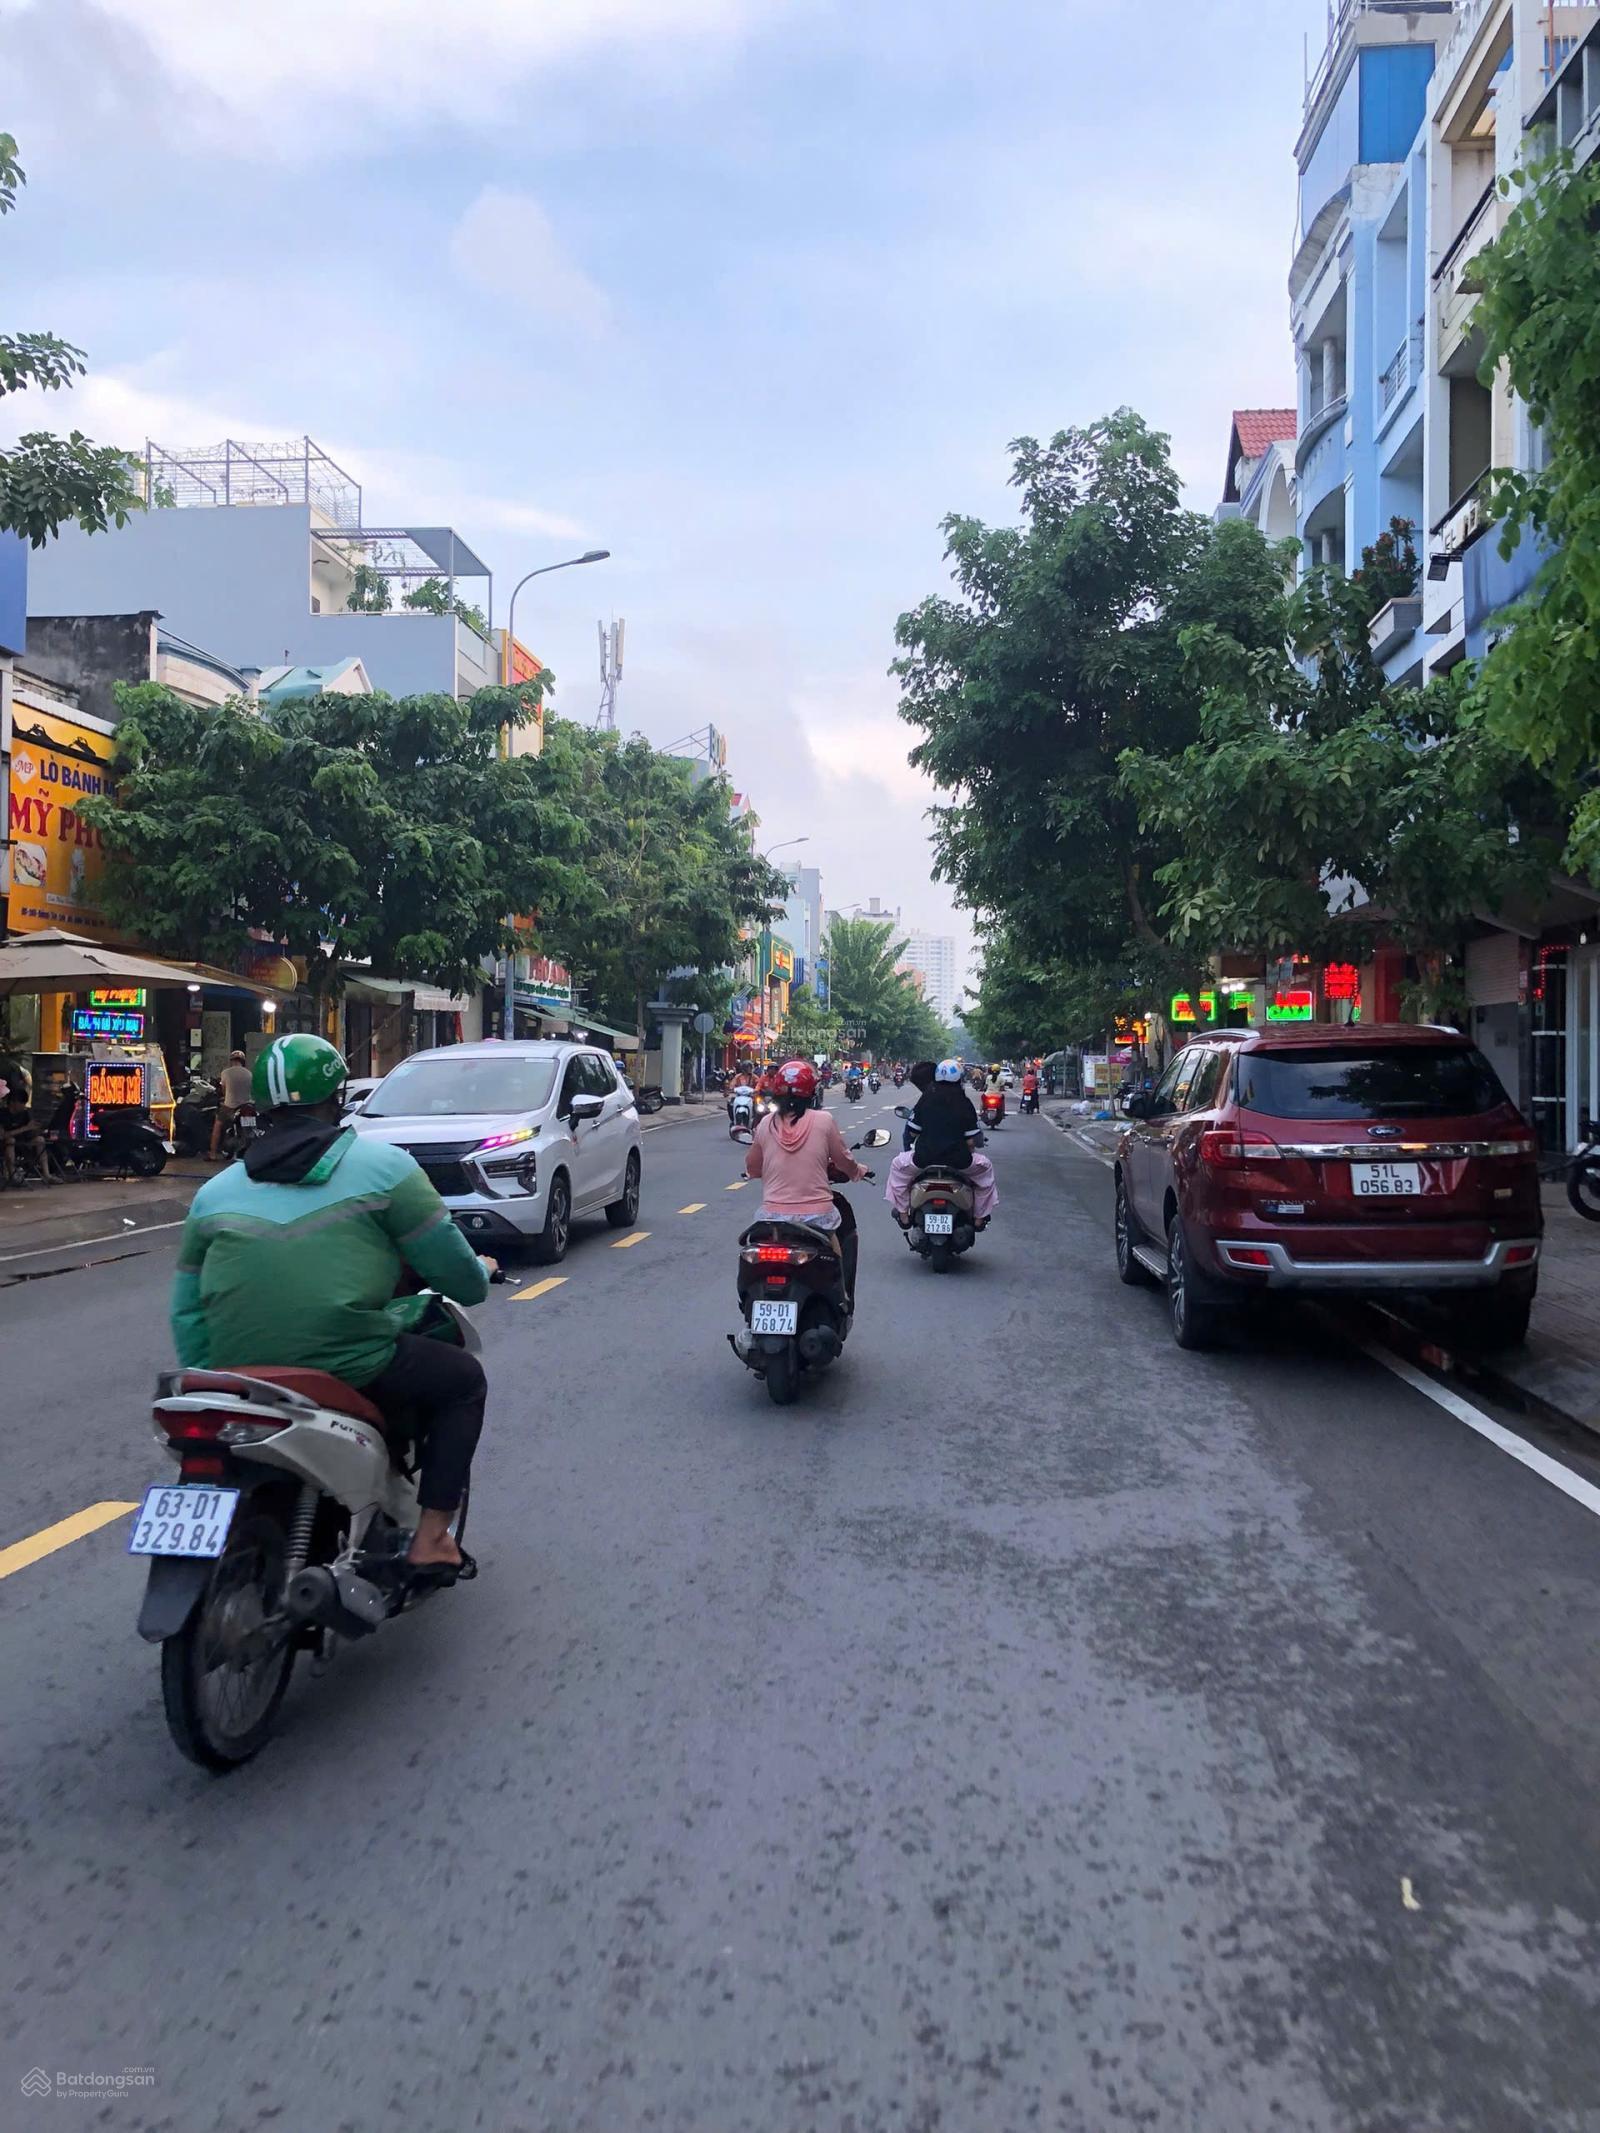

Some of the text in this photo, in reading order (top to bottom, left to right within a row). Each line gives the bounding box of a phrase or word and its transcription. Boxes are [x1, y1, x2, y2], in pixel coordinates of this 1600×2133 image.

[40, 754, 59, 783] LÒ
[62, 763, 101, 795] BÁNH
[9, 788, 105, 850] MỸ PH
[90, 1067, 125, 1105] BÁNH
[1370, 1165, 1400, 1178] 51L
[1360, 1179, 1413, 1194] 056.83
[759, 1303, 790, 1317] 59-D1
[754, 1318, 793, 1332] 768.74
[155, 1491, 222, 1520] 63-D1
[136, 1521, 219, 1553] 329.84
